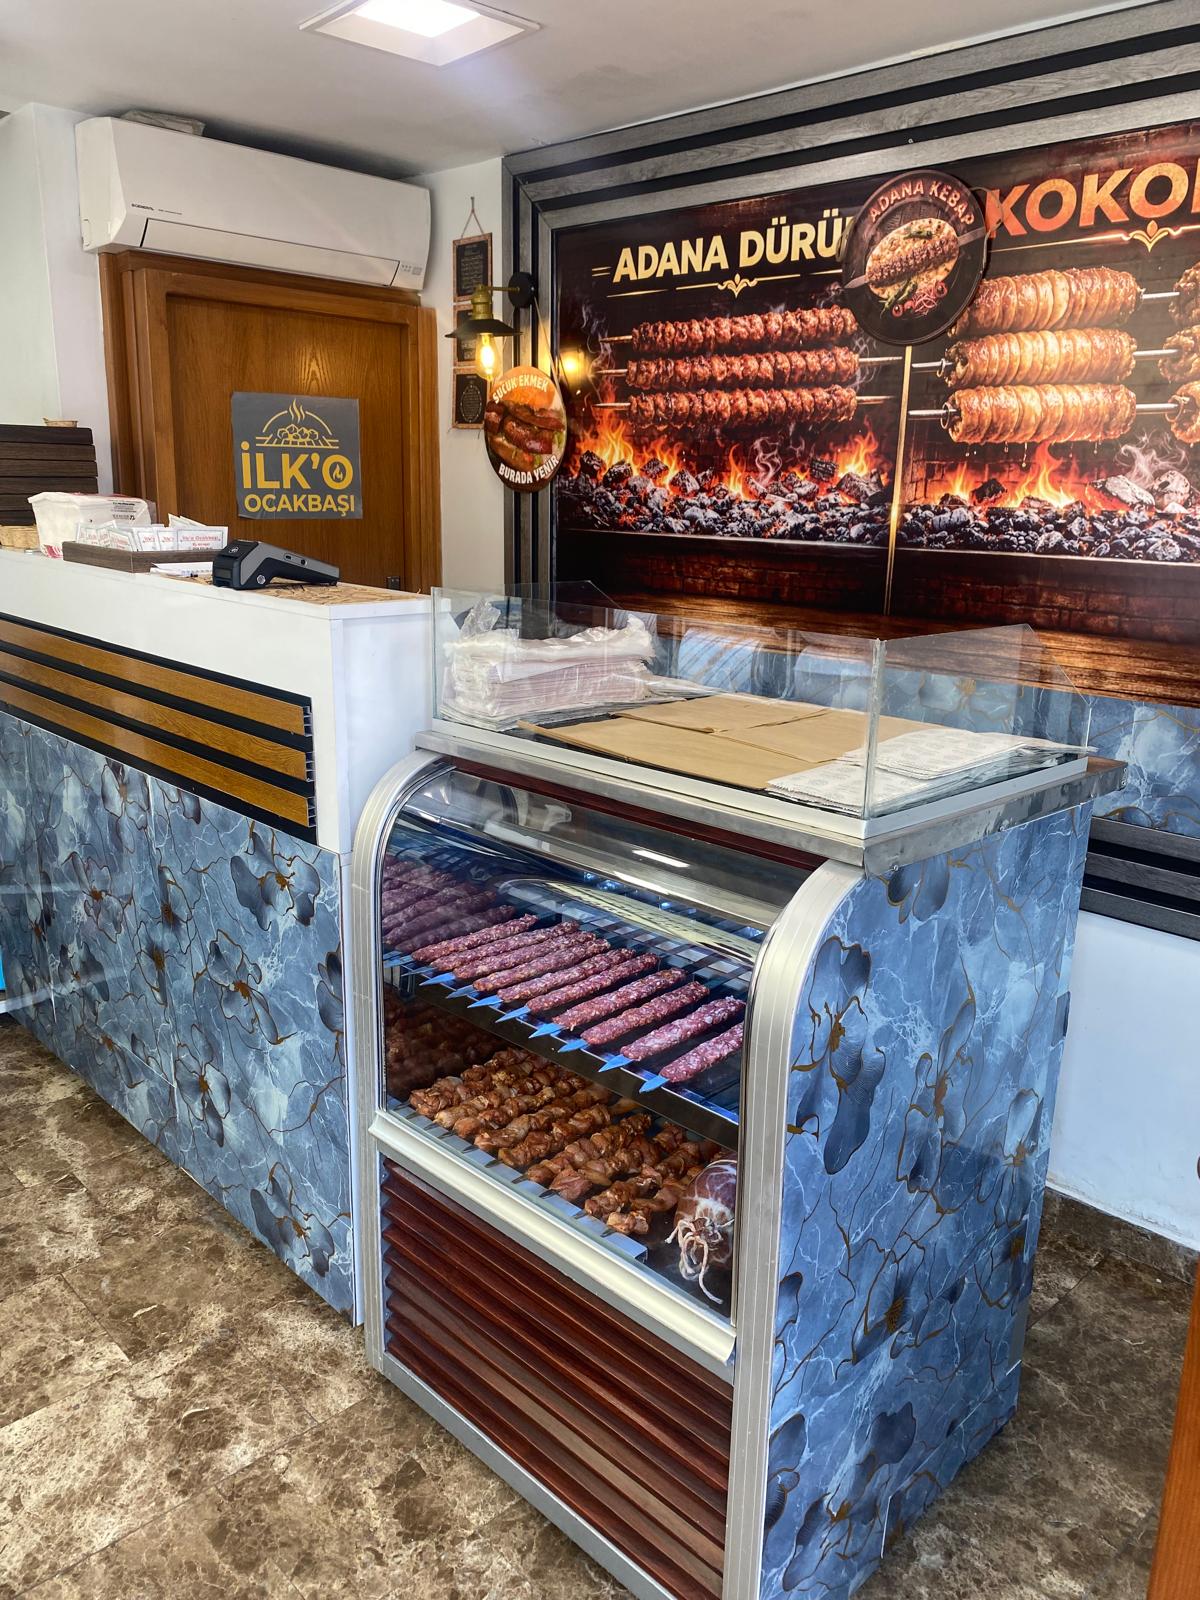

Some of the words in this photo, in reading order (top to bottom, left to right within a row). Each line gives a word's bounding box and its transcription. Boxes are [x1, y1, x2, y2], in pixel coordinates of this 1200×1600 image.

[869, 181, 925, 223] ADANA
[929, 180, 975, 226] KEBAP
[985, 159, 1200, 239] KOKO
[612, 234, 729, 284] ADANA
[739, 208, 854, 268] DÜRÜ
[492, 376, 518, 405] SUCUK
[518, 374, 549, 393] EKMEK
[498, 462, 533, 484] BURADA
[244, 493, 355, 517] OCAKBAŞI
